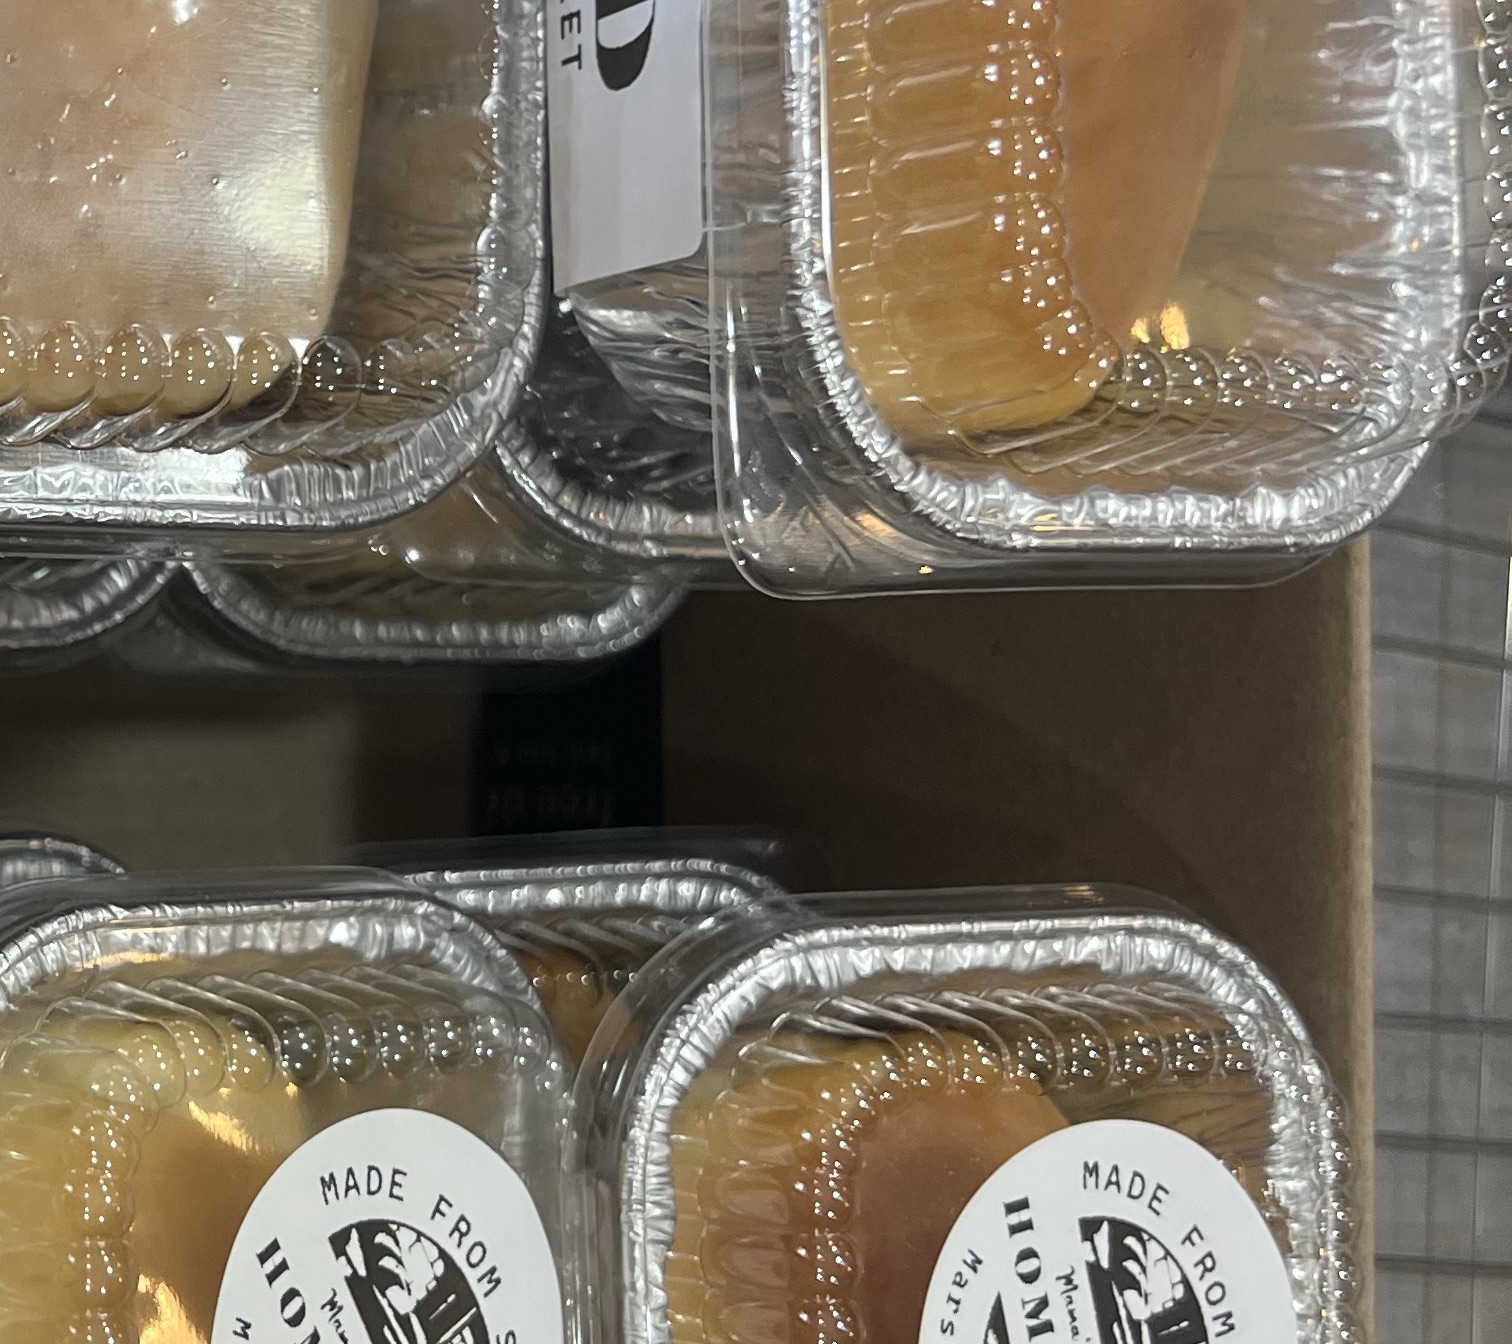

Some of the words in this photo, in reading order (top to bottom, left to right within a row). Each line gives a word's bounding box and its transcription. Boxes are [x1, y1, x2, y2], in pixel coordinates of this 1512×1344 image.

[319, 1165, 408, 1205] MADE
[429, 1194, 502, 1297] FROM
[1083, 1160, 1170, 1216] MADE
[1180, 1224, 1236, 1339] FROM
